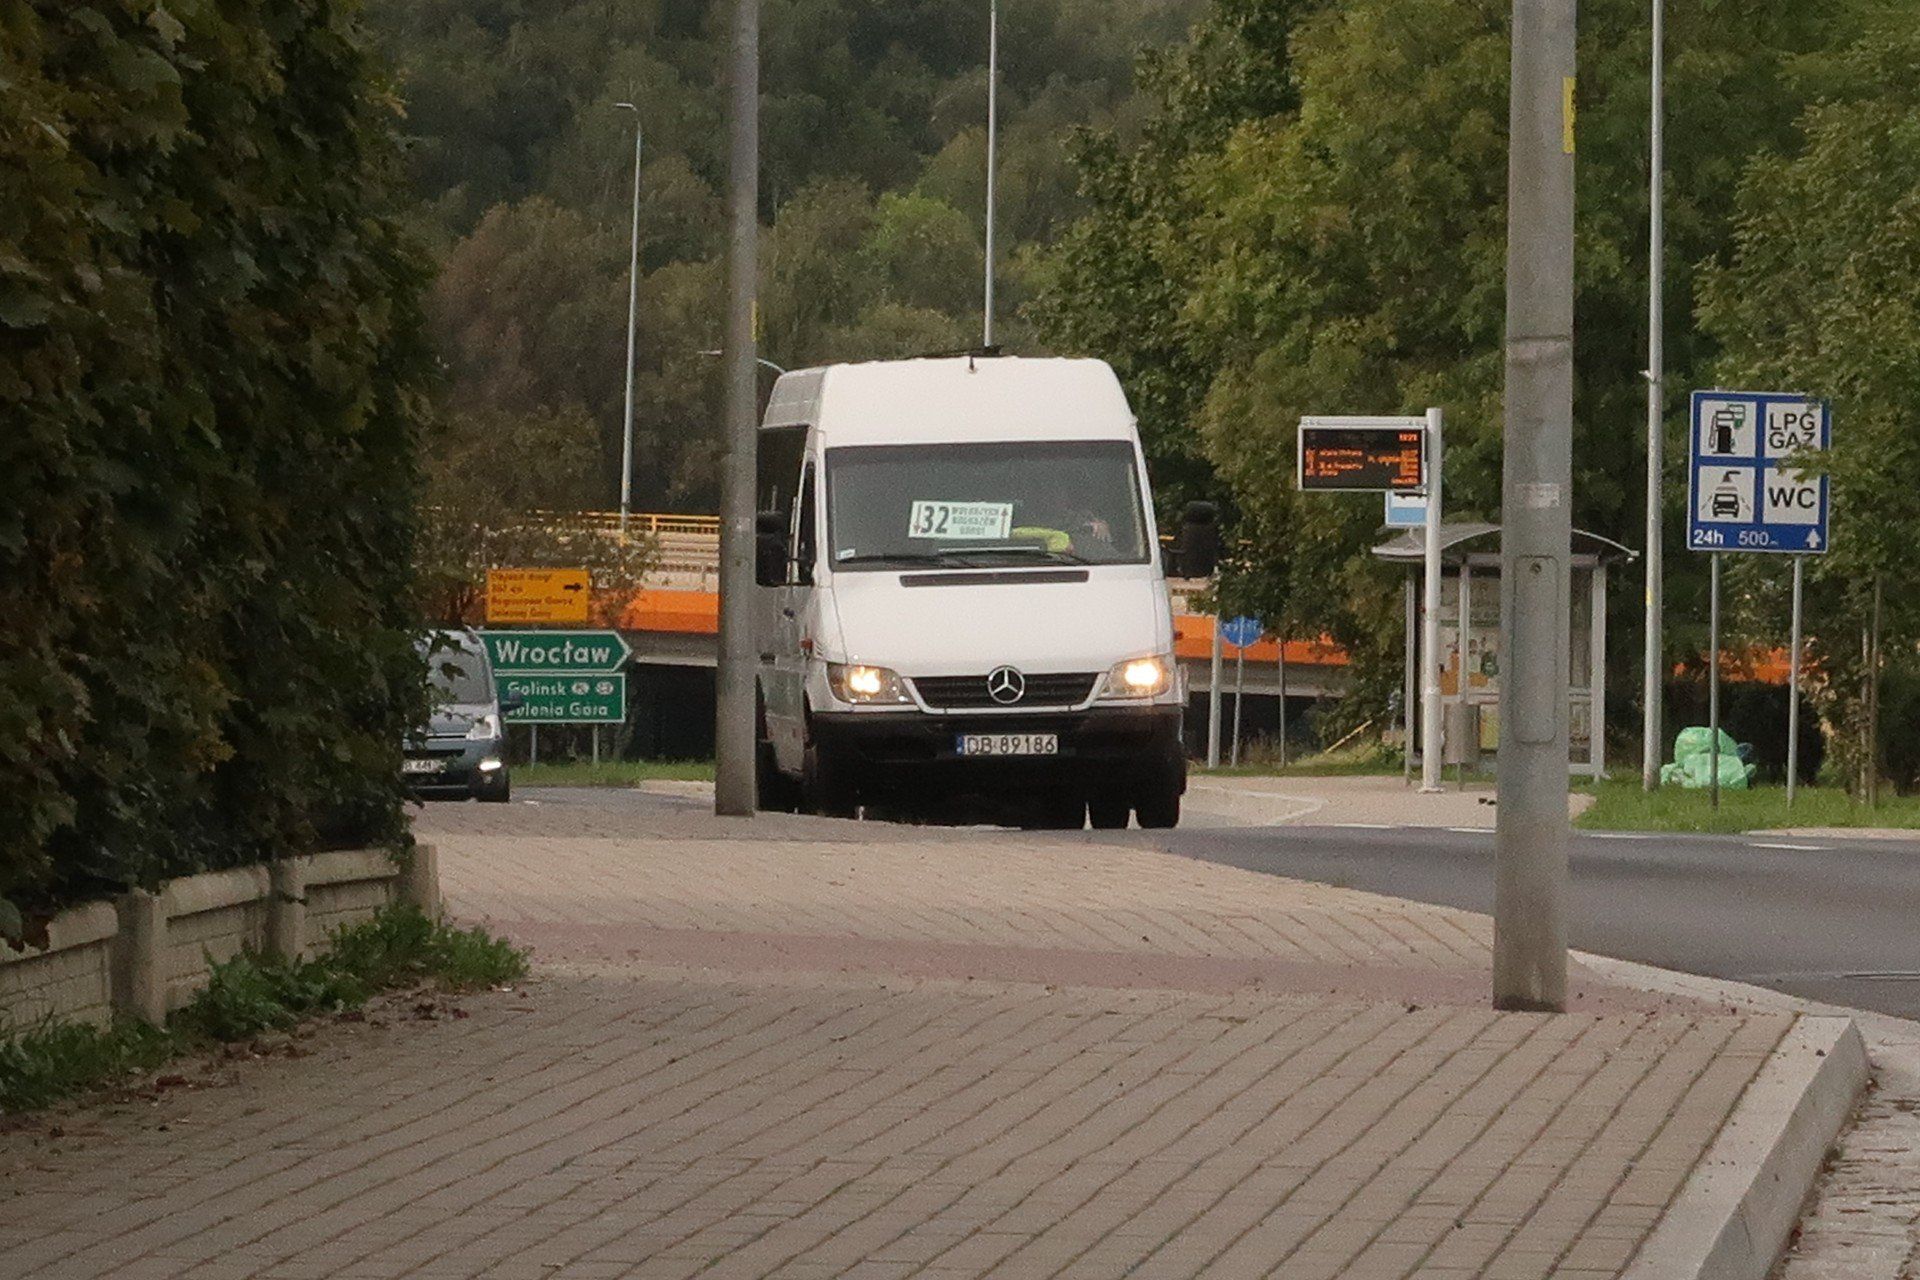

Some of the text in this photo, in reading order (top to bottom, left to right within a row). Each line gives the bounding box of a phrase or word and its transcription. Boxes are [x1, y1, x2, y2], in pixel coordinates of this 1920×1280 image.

[1769, 412, 1815, 431] LPG
[1768, 487, 1815, 509] WC
[920, 505, 950, 534] 32
[1693, 529, 1724, 545] 24h
[495, 638, 611, 664] Wrocław
[967, 736, 1055, 754] DB 89186
